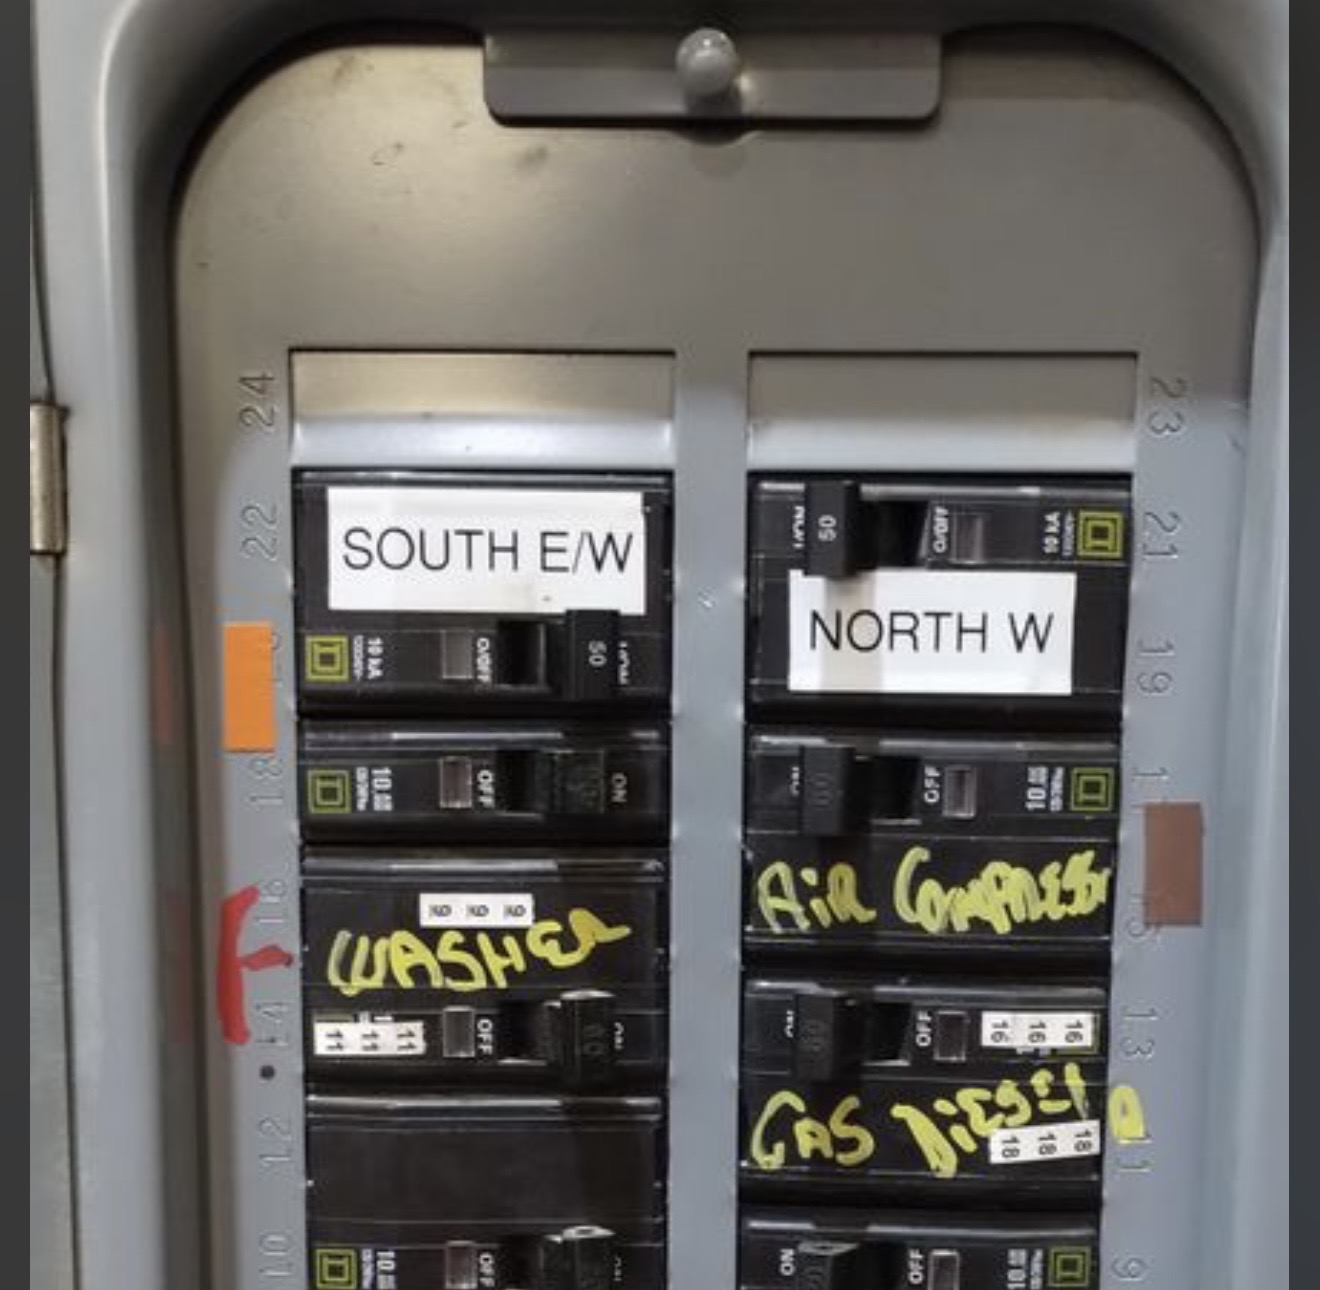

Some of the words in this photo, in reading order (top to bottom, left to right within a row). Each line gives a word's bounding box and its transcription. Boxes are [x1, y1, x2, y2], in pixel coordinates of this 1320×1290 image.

[239, 373, 275, 432] 24
[1150, 377, 1187, 436] 23
[240, 504, 277, 560] 22
[817, 515, 836, 541] 50
[1143, 511, 1180, 560] 21
[342, 527, 519, 571] SOUTH
[539, 531, 634, 573] E/W
[809, 610, 987, 652] NORTH
[1008, 612, 1054, 653] W
[588, 640, 607, 668] 50
[1137, 638, 1175, 694] 19
[477, 769, 495, 808] OFF
[611, 772, 628, 803] ON
[923, 765, 941, 804] OFF
[327, 908, 632, 997] WASHER
[477, 1018, 493, 1055] OFF
[915, 1010, 932, 1047] OFF
[991, 1021, 1010, 1043] 16
[1028, 1021, 1046, 1043] 16
[1065, 1020, 1084, 1042] 16
[1121, 1008, 1158, 1058] 13
[259, 1118, 292, 1165] 12
[752, 1089, 876, 1170] GAS
[1002, 1135, 1020, 1159] 18
[1038, 1132, 1057, 1155] 18
[1074, 1129, 1093, 1152] 18
[260, 1234, 295, 1277] 10
[479, 1252, 495, 1287] OFF
[780, 1249, 796, 1277] ON
[908, 1250, 925, 1285] OFF
[1111, 1257, 1148, 1283] 9
